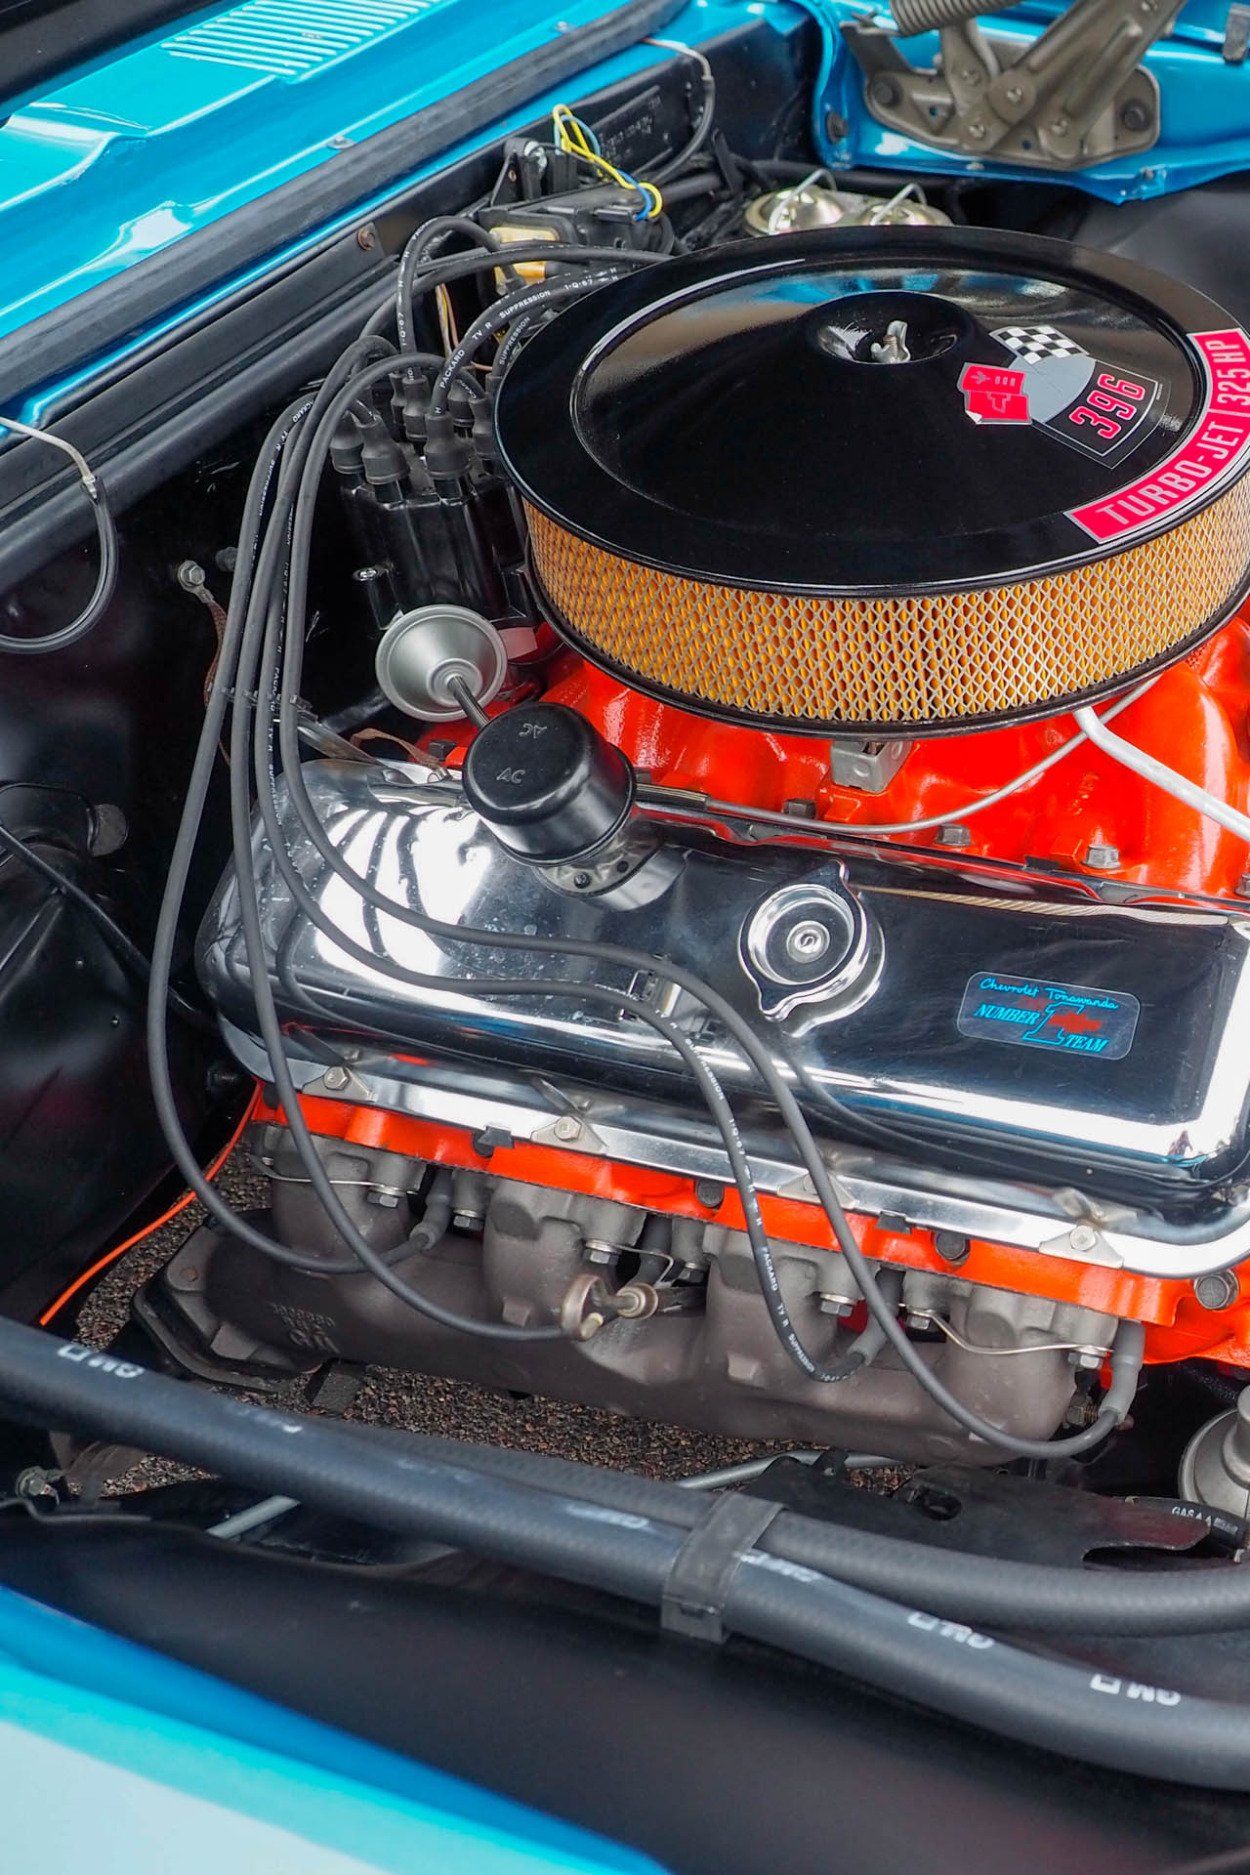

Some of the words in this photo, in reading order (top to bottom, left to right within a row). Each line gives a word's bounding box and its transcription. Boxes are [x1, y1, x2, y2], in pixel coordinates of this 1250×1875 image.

[499, 290, 551, 319] SUPPRESSION
[1068, 373, 1146, 440] 396
[1095, 421, 1245, 525] TURBO-JET
[1206, 340, 1247, 363] HP
[496, 767, 526, 785] AC
[979, 978, 1039, 997] Chevrolet
[1044, 987, 1119, 1010] Tonawanda
[974, 1004, 1041, 1026] NUMBER
[1063, 1034, 1110, 1053] TEAM
